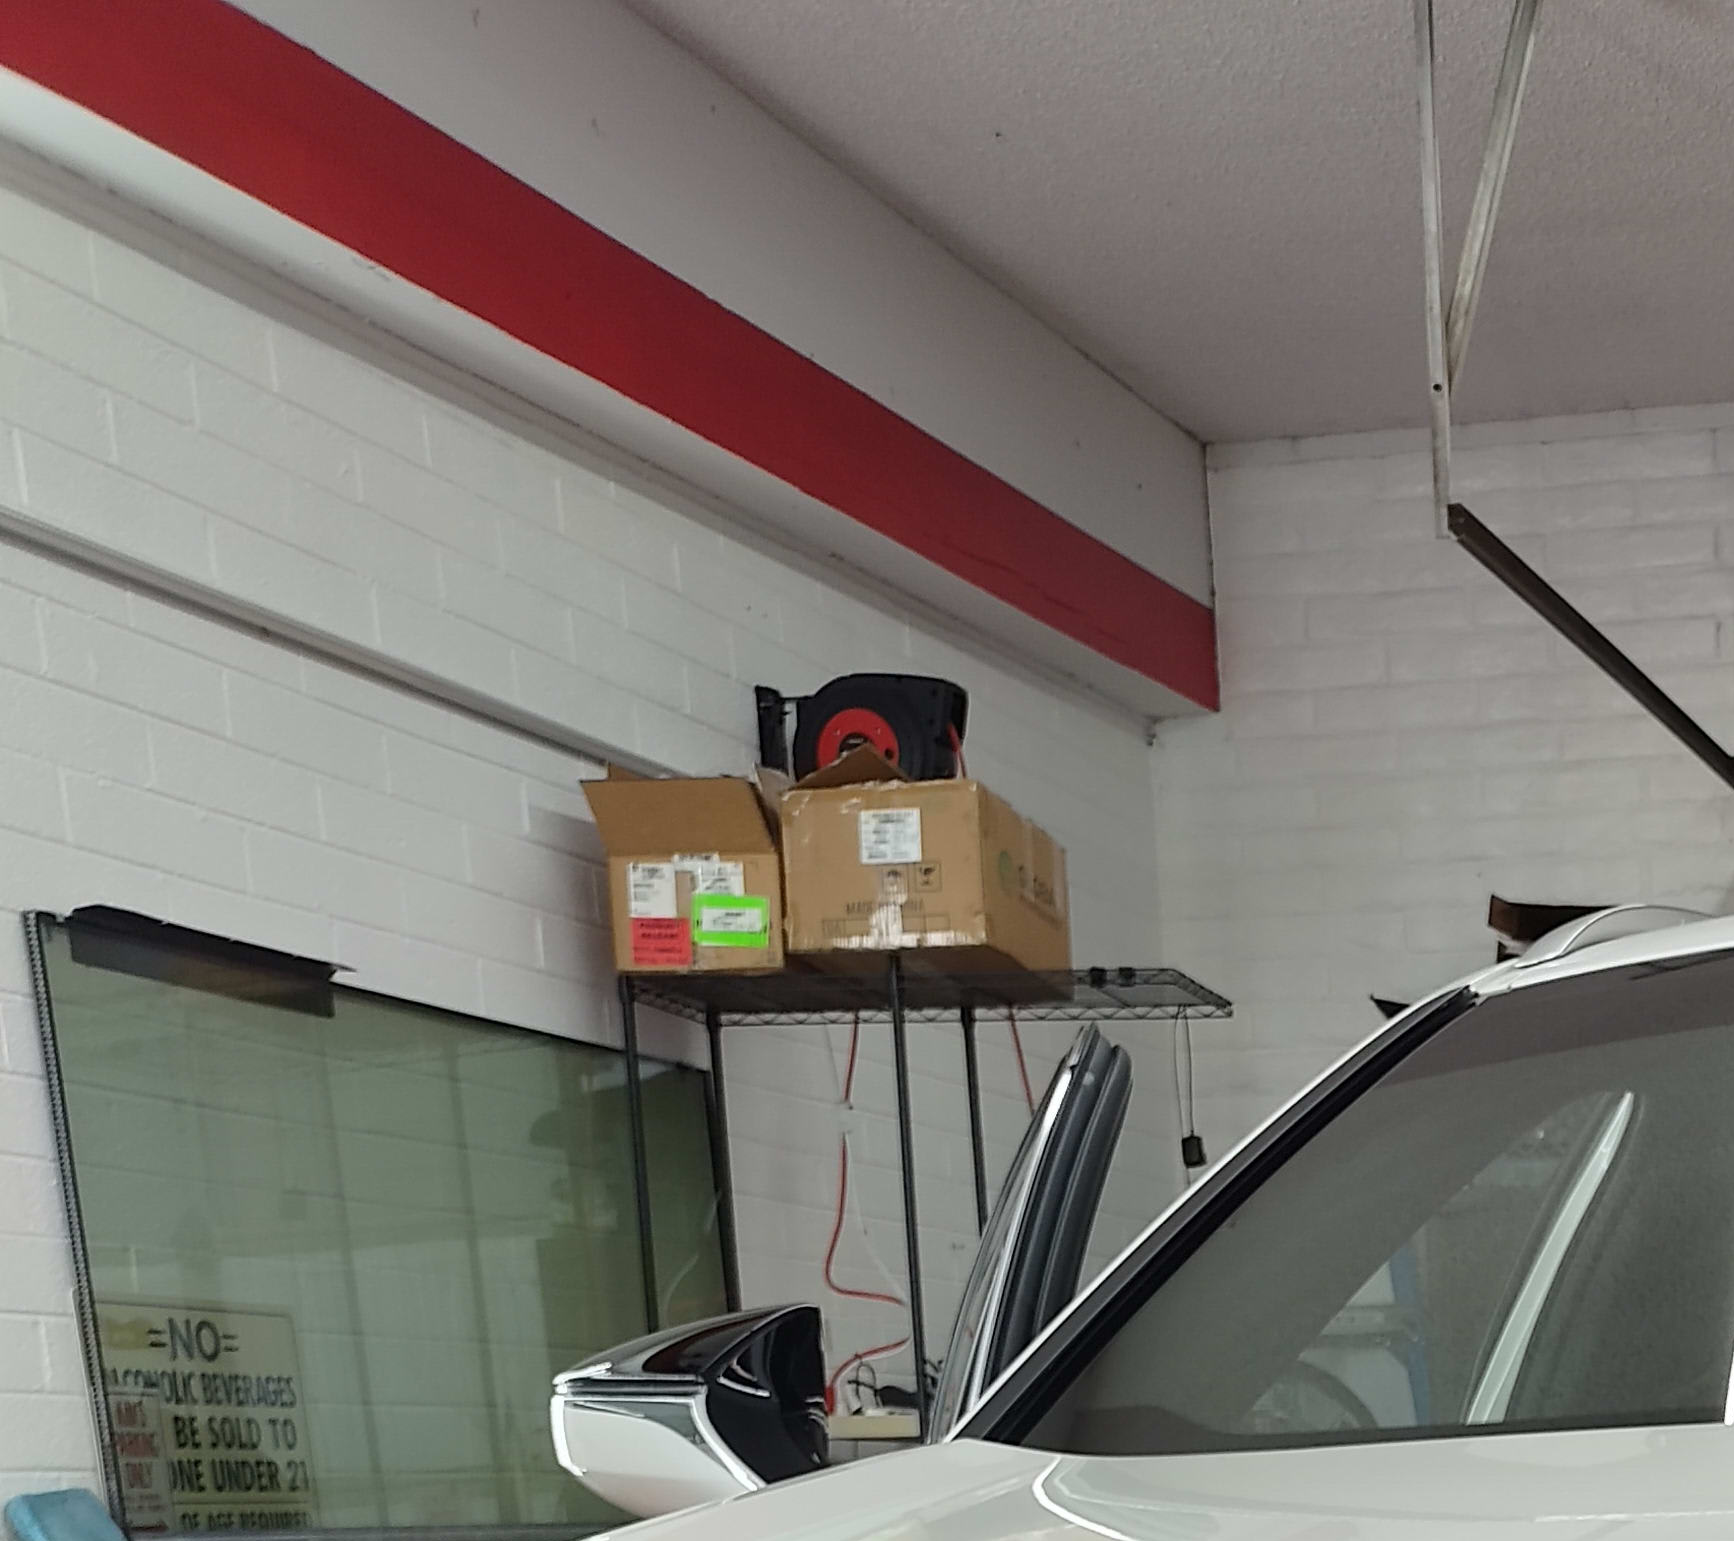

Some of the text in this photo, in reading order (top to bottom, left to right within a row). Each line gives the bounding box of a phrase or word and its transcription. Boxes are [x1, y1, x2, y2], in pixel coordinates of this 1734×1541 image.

[201, 1372, 297, 1408] BEVERAGES
[173, 1416, 202, 1449] BE
[208, 1416, 262, 1450] SOLD
[268, 1417, 297, 1450] TO
[210, 1458, 281, 1493] UNDER
[287, 1460, 309, 1492] 21
